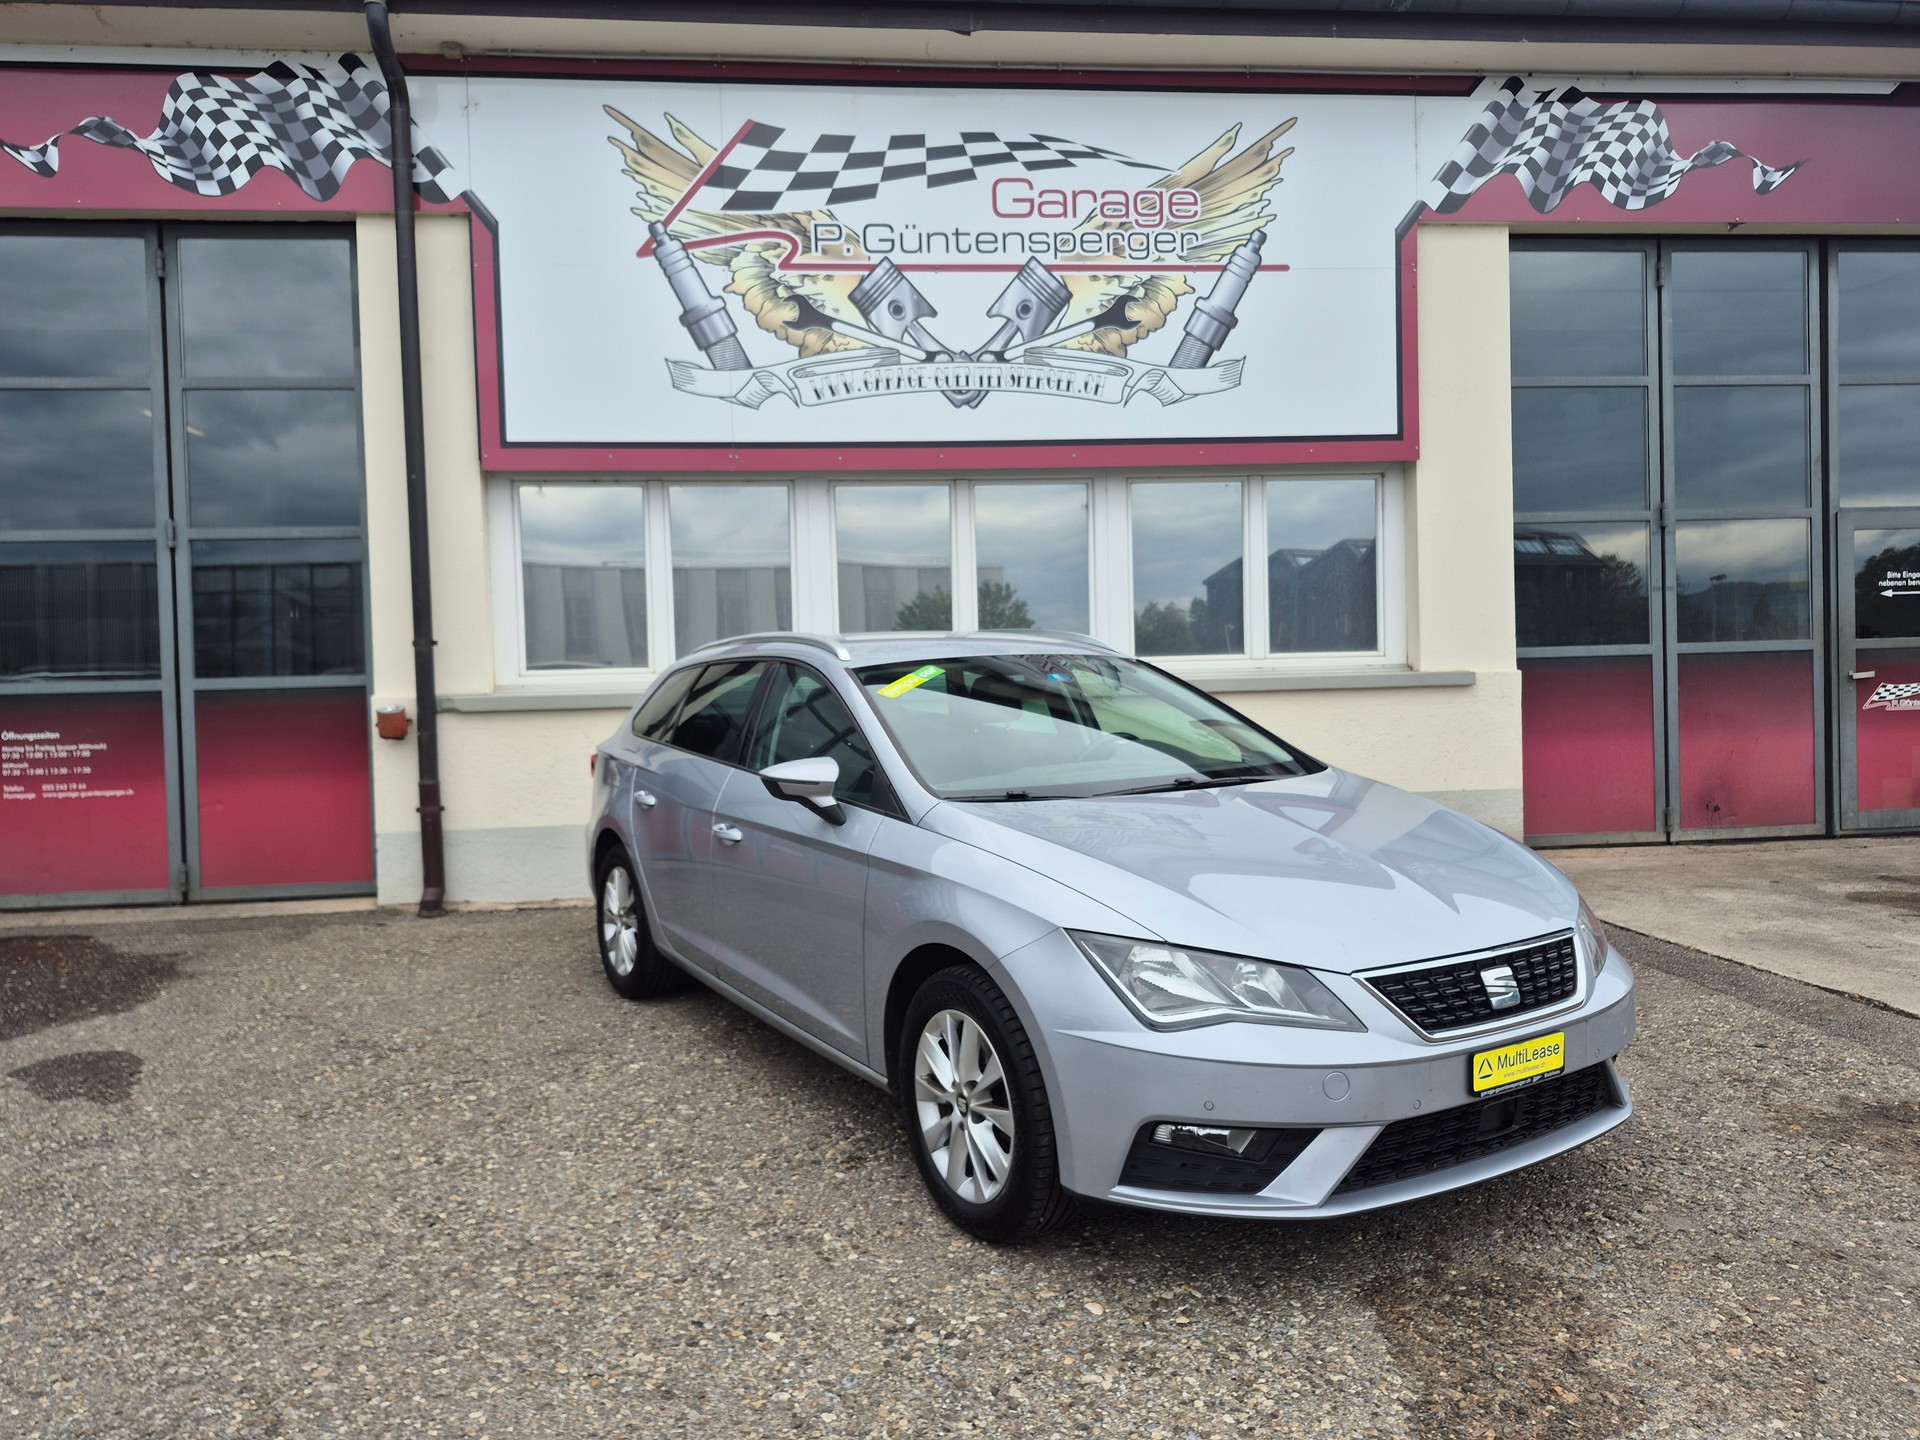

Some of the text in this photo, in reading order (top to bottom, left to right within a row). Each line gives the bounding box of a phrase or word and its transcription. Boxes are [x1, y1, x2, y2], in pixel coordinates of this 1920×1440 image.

[991, 177, 1200, 229] Garage
[1886, 571, 1902, 579] Bitte
[1878, 579, 1907, 587] nebenan
[0, 730, 61, 742] Öffnungszeiten
[1497, 1041, 1561, 1071] MultiLease
